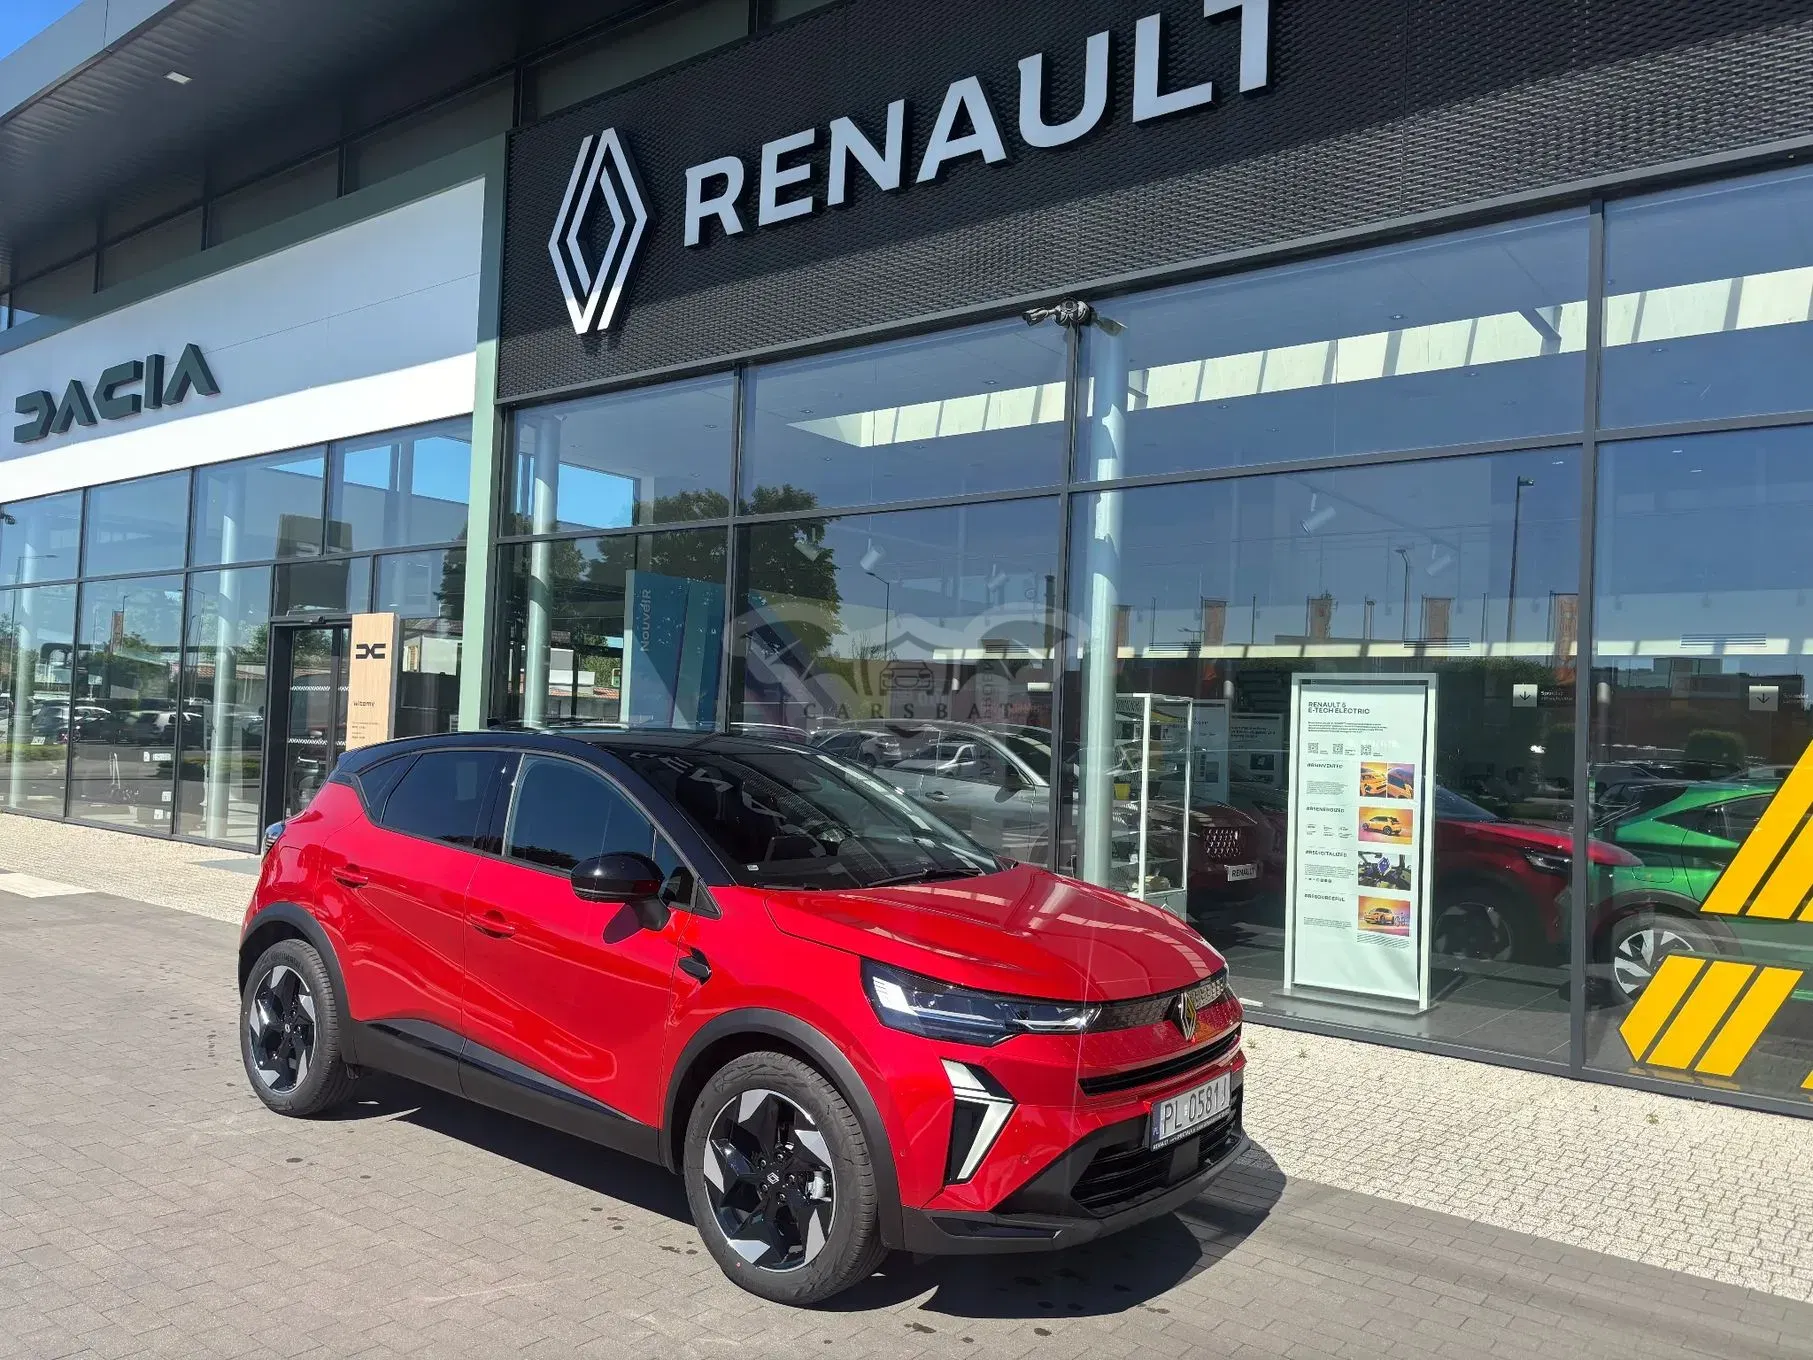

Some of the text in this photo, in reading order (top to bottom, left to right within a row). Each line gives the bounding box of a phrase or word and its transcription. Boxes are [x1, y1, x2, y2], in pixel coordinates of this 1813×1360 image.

[684, 0, 1269, 248] RENAULT
[14, 343, 221, 443] DACIA
[1163, 1101, 1183, 1134] PL
